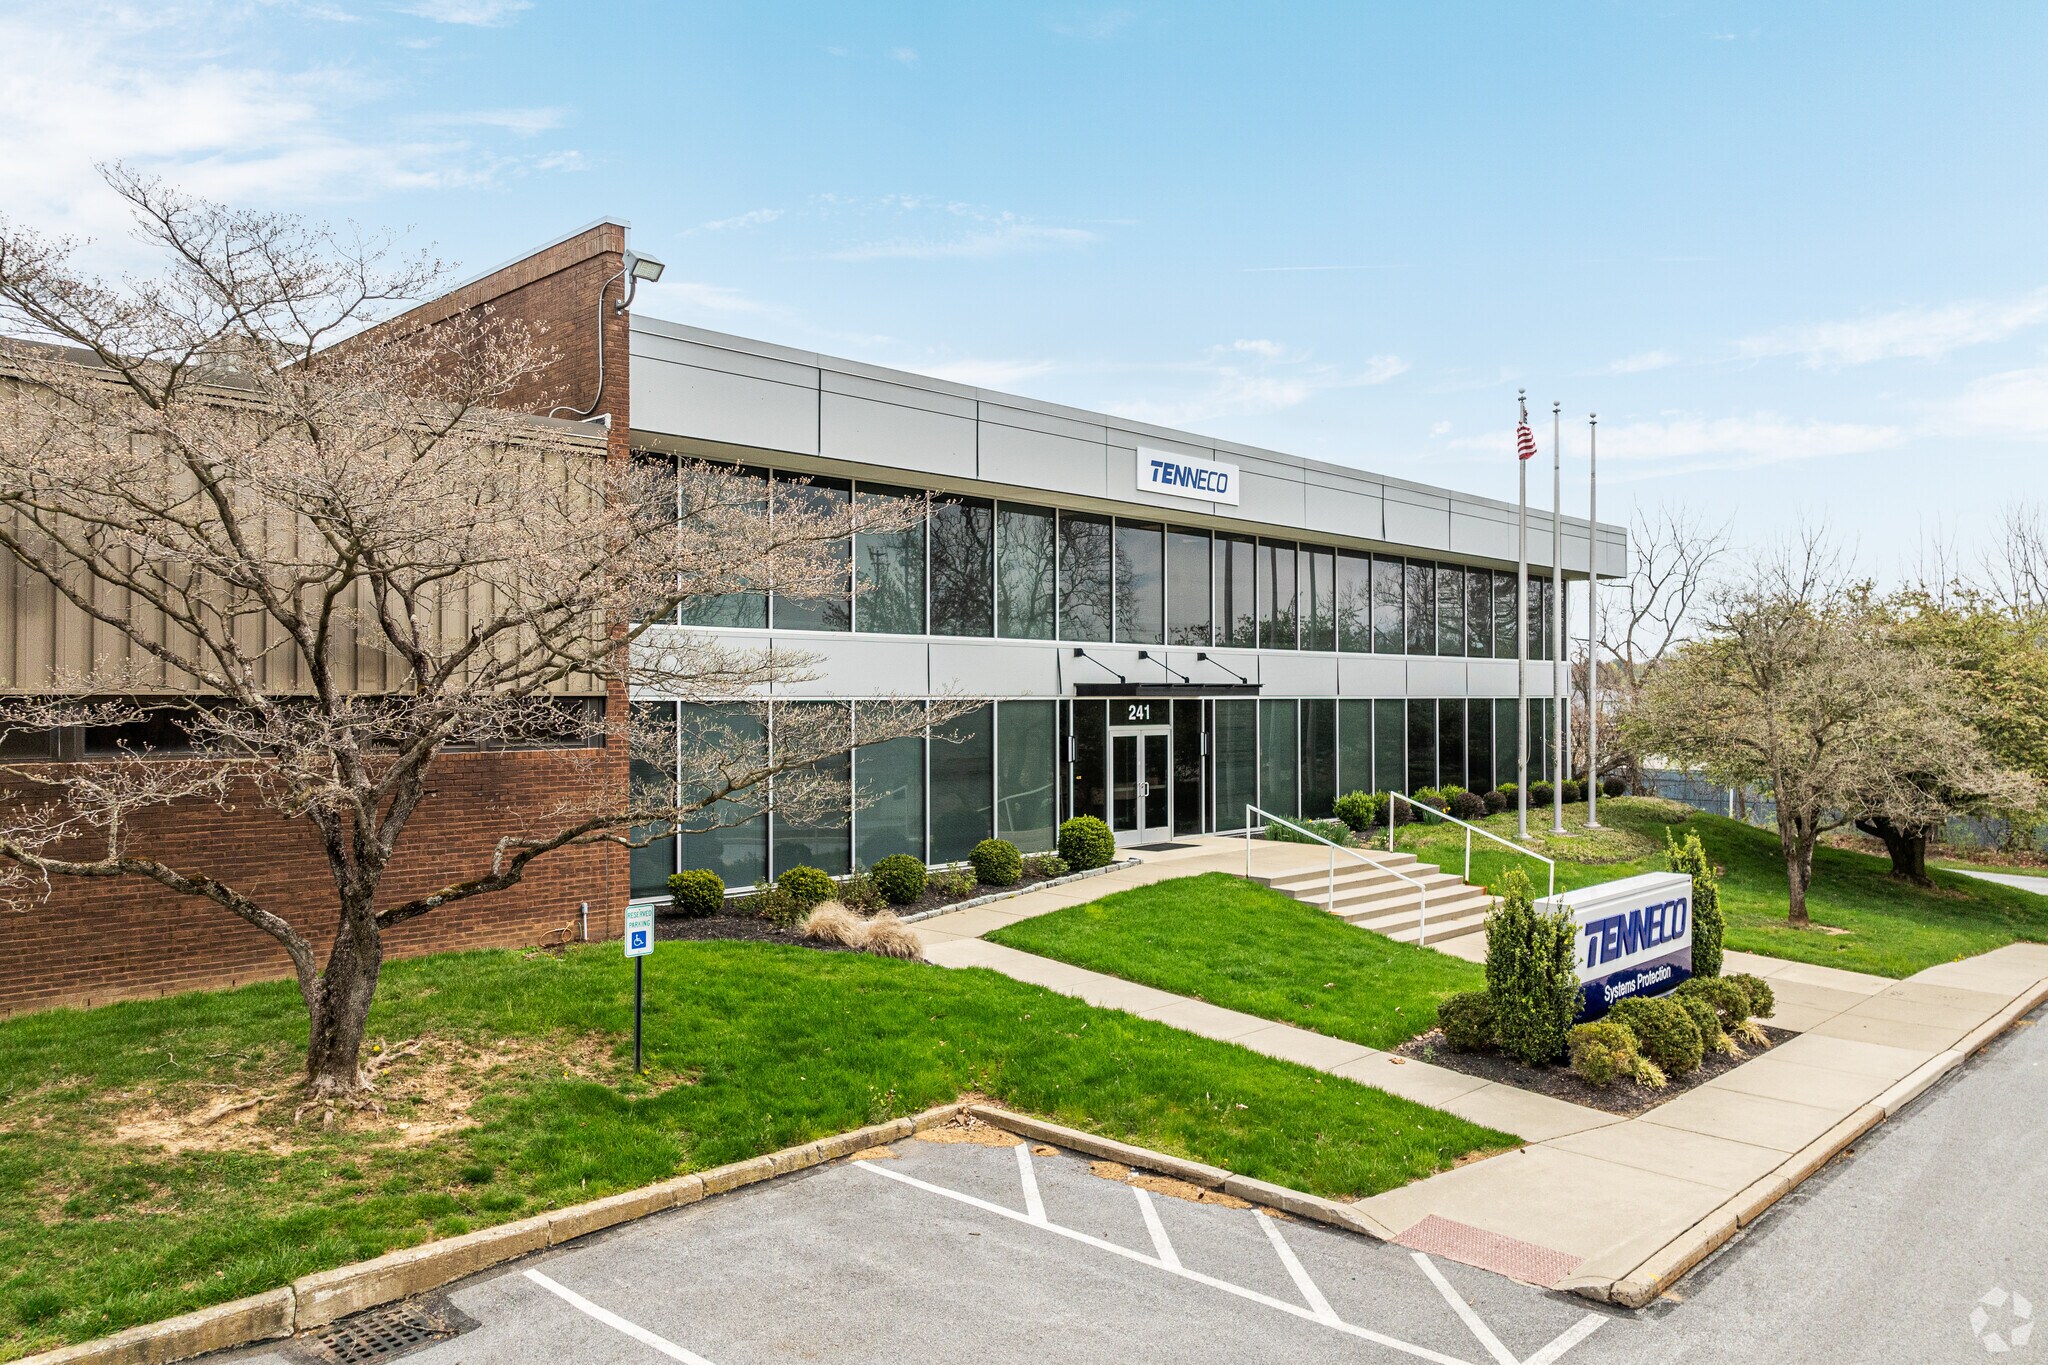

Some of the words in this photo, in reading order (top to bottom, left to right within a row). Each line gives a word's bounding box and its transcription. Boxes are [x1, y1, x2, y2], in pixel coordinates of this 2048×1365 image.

[1150, 460, 1229, 494] TENNECO
[1128, 704, 1150, 720] 241
[627, 910, 652, 918] RESERVED
[628, 920, 651, 928] PARKING
[1584, 897, 1688, 969] TENNECO
[1604, 980, 1636, 1003] Systems
[1637, 965, 1671, 989] Protection
